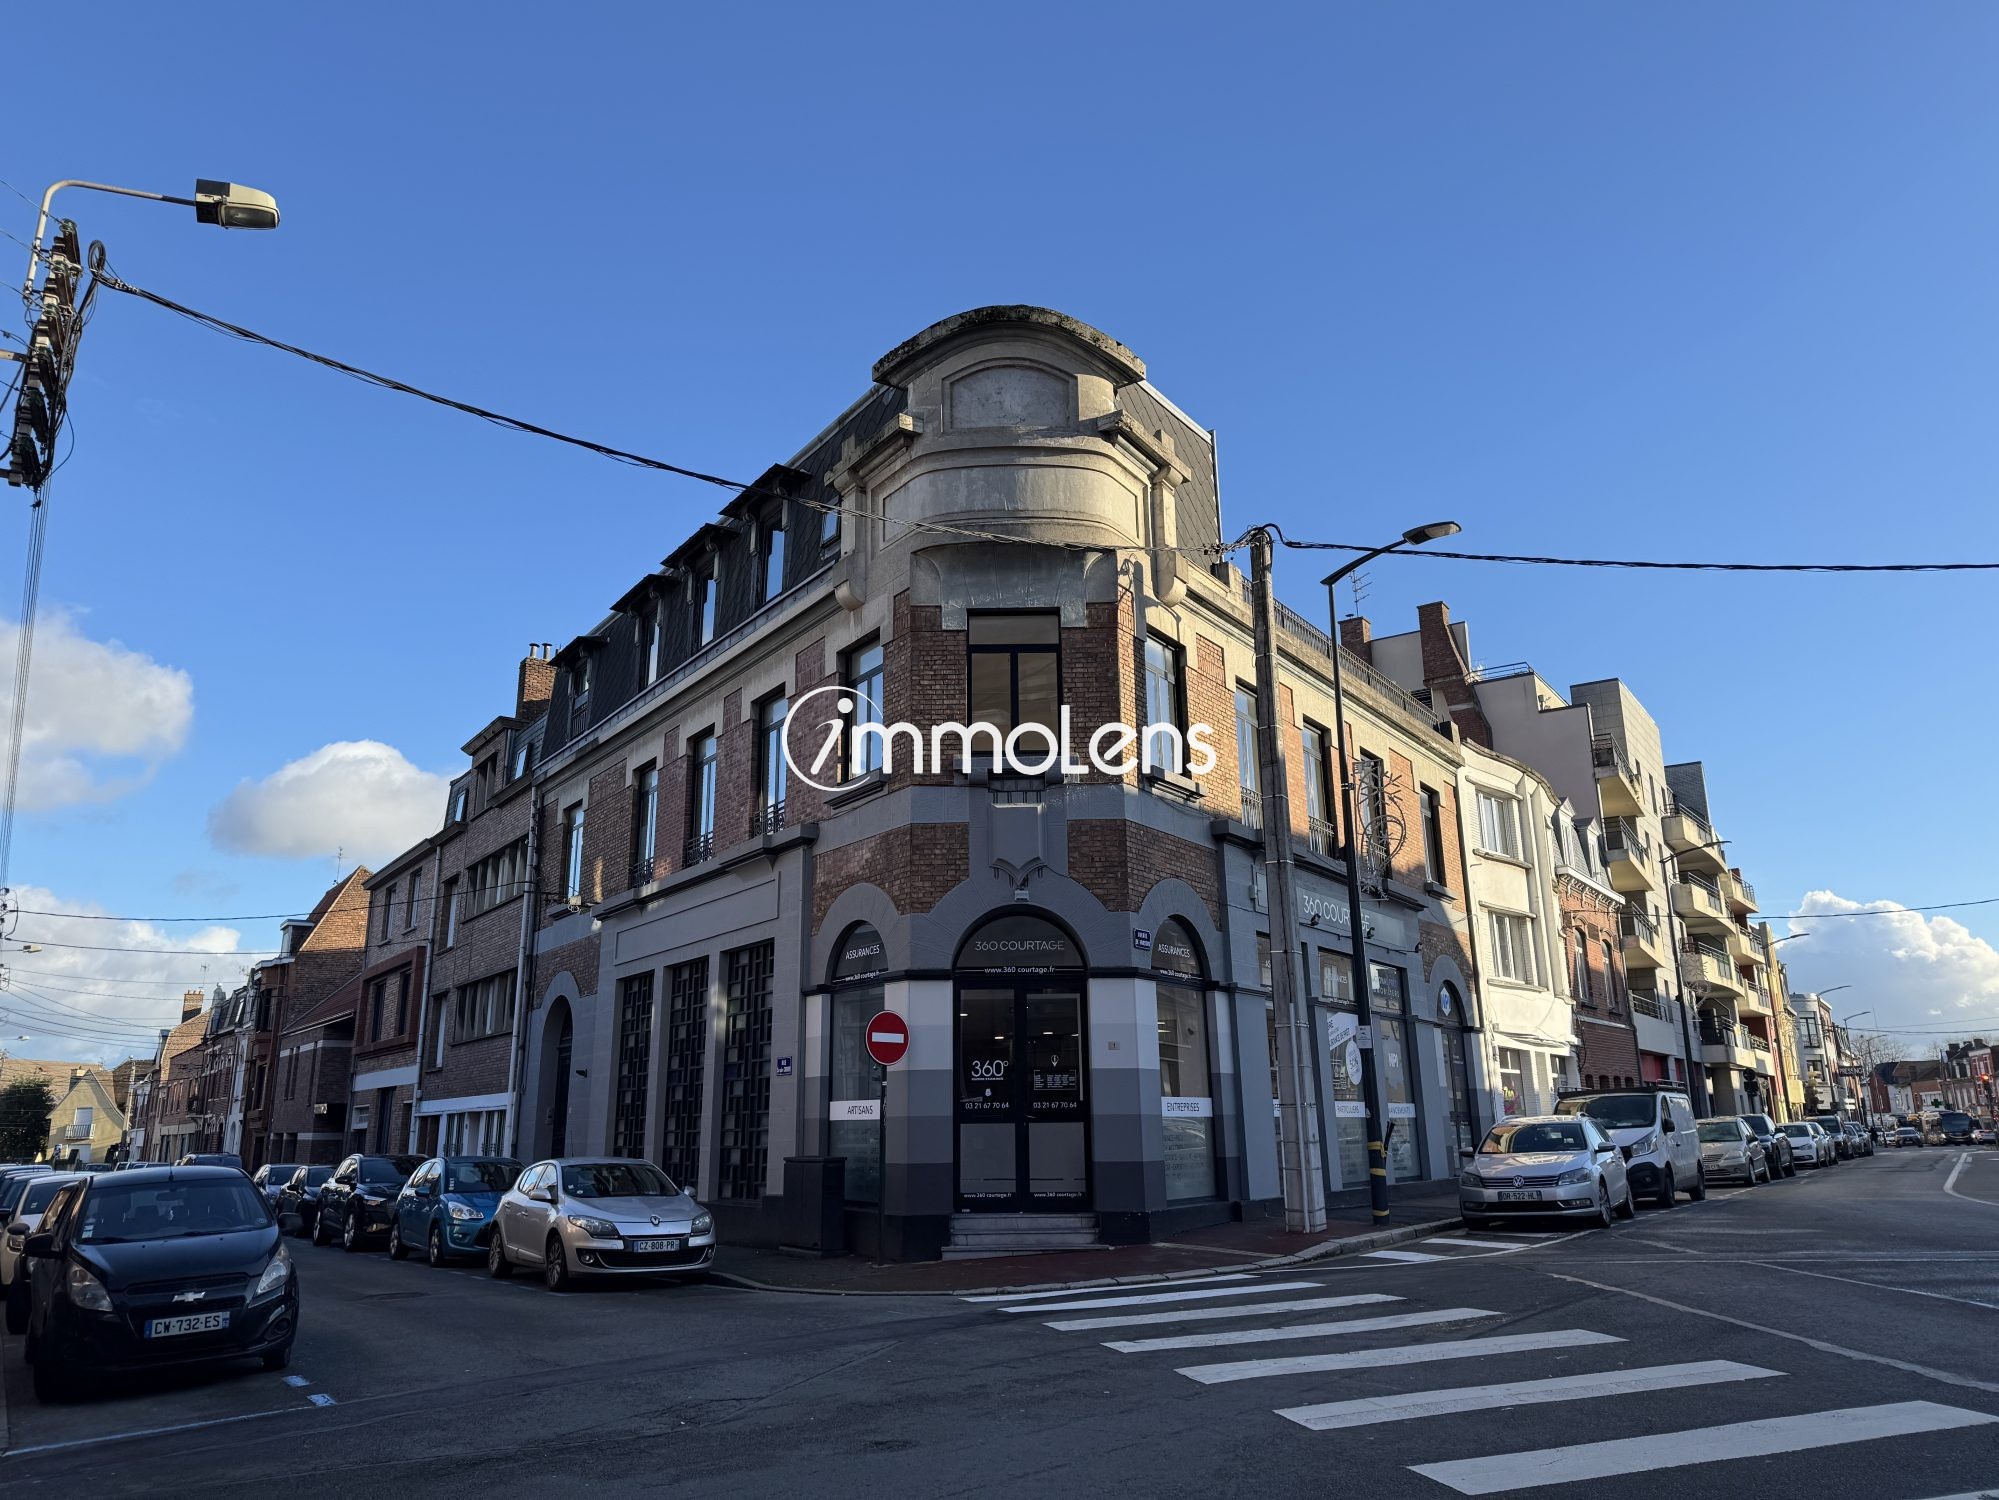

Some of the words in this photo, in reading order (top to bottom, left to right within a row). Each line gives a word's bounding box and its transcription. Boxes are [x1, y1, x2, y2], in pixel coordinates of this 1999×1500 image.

[1303, 895, 1322, 916] 360
[1323, 902, 1370, 931] COURGE
[975, 941, 999, 951] 360
[1000, 940, 1065, 951] COURTAGE
[1158, 943, 1191, 958] ASSURANCES
[845, 944, 880, 960] ASSURANCES
[1017, 965, 1055, 975] courtage.fr
[1838, 1066, 1864, 1074] PRESSNG
[847, 1105, 874, 1115] ARTISANS
[1033, 1101, 1041, 1109] 03
[1042, 1101, 1050, 1109] 21
[1051, 1101, 1059, 1109] 67
[1060, 1101, 1068, 1109] 70
[1069, 1101, 1077, 1109] 64
[1166, 1102, 1200, 1112] ENTREPRISES
[154, 1315, 221, 1335] CW-732-ES
